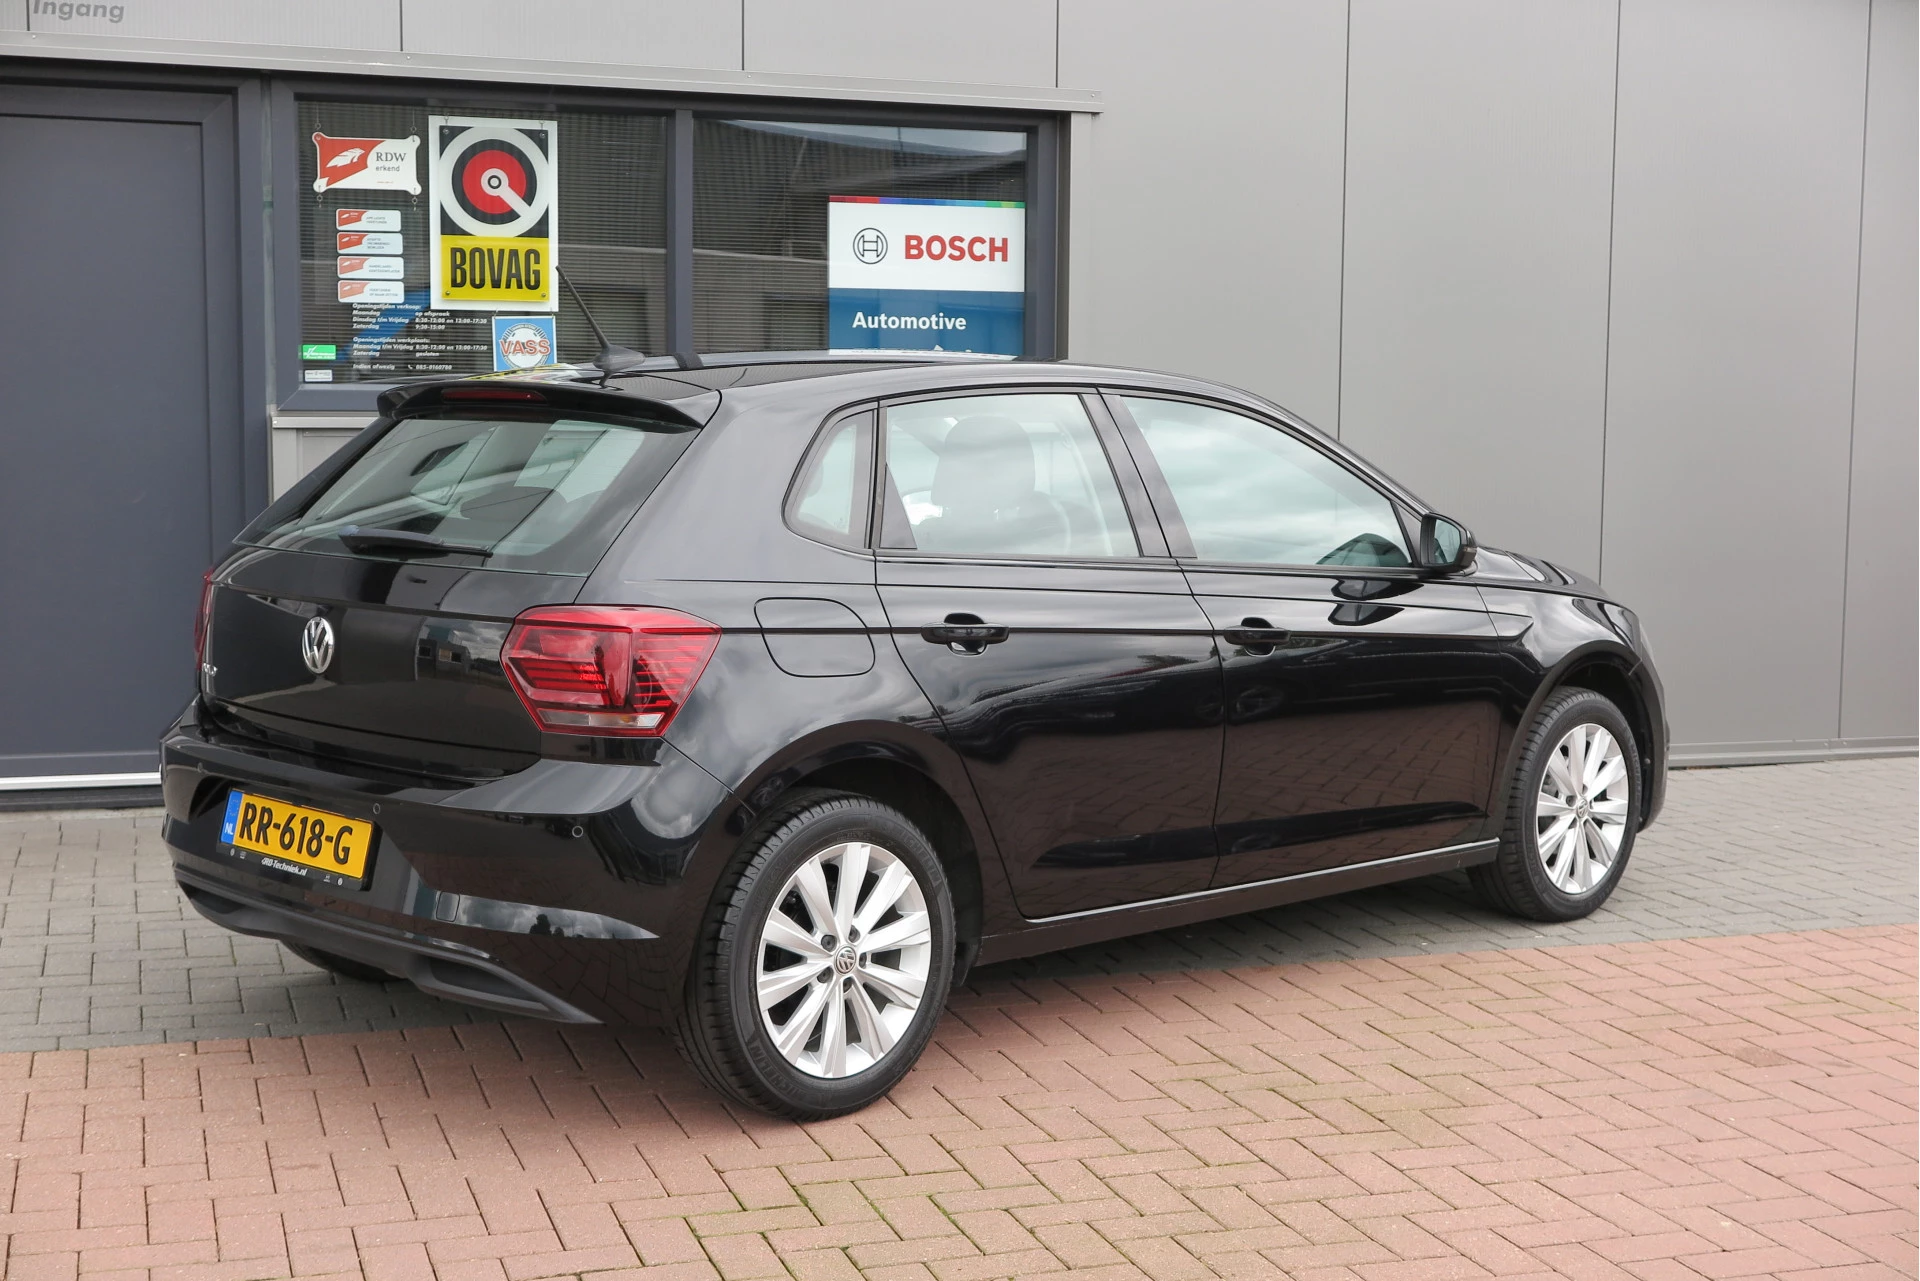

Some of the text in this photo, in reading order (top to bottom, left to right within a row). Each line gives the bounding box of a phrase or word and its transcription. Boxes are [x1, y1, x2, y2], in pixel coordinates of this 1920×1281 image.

[33, 0, 124, 23] Ingang
[375, 151, 407, 162] RDW
[375, 164, 400, 172] erkend
[904, 234, 1008, 262] BOSCH
[450, 247, 541, 290] BOVAG
[352, 303, 396, 311] Openingstijden
[852, 311, 967, 330] Automotive
[352, 336, 396, 344] Openingstijden
[352, 343, 381, 351] Maandag
[499, 338, 551, 356] VASS
[224, 822, 234, 835] NL
[239, 802, 353, 865] RR-618-G
